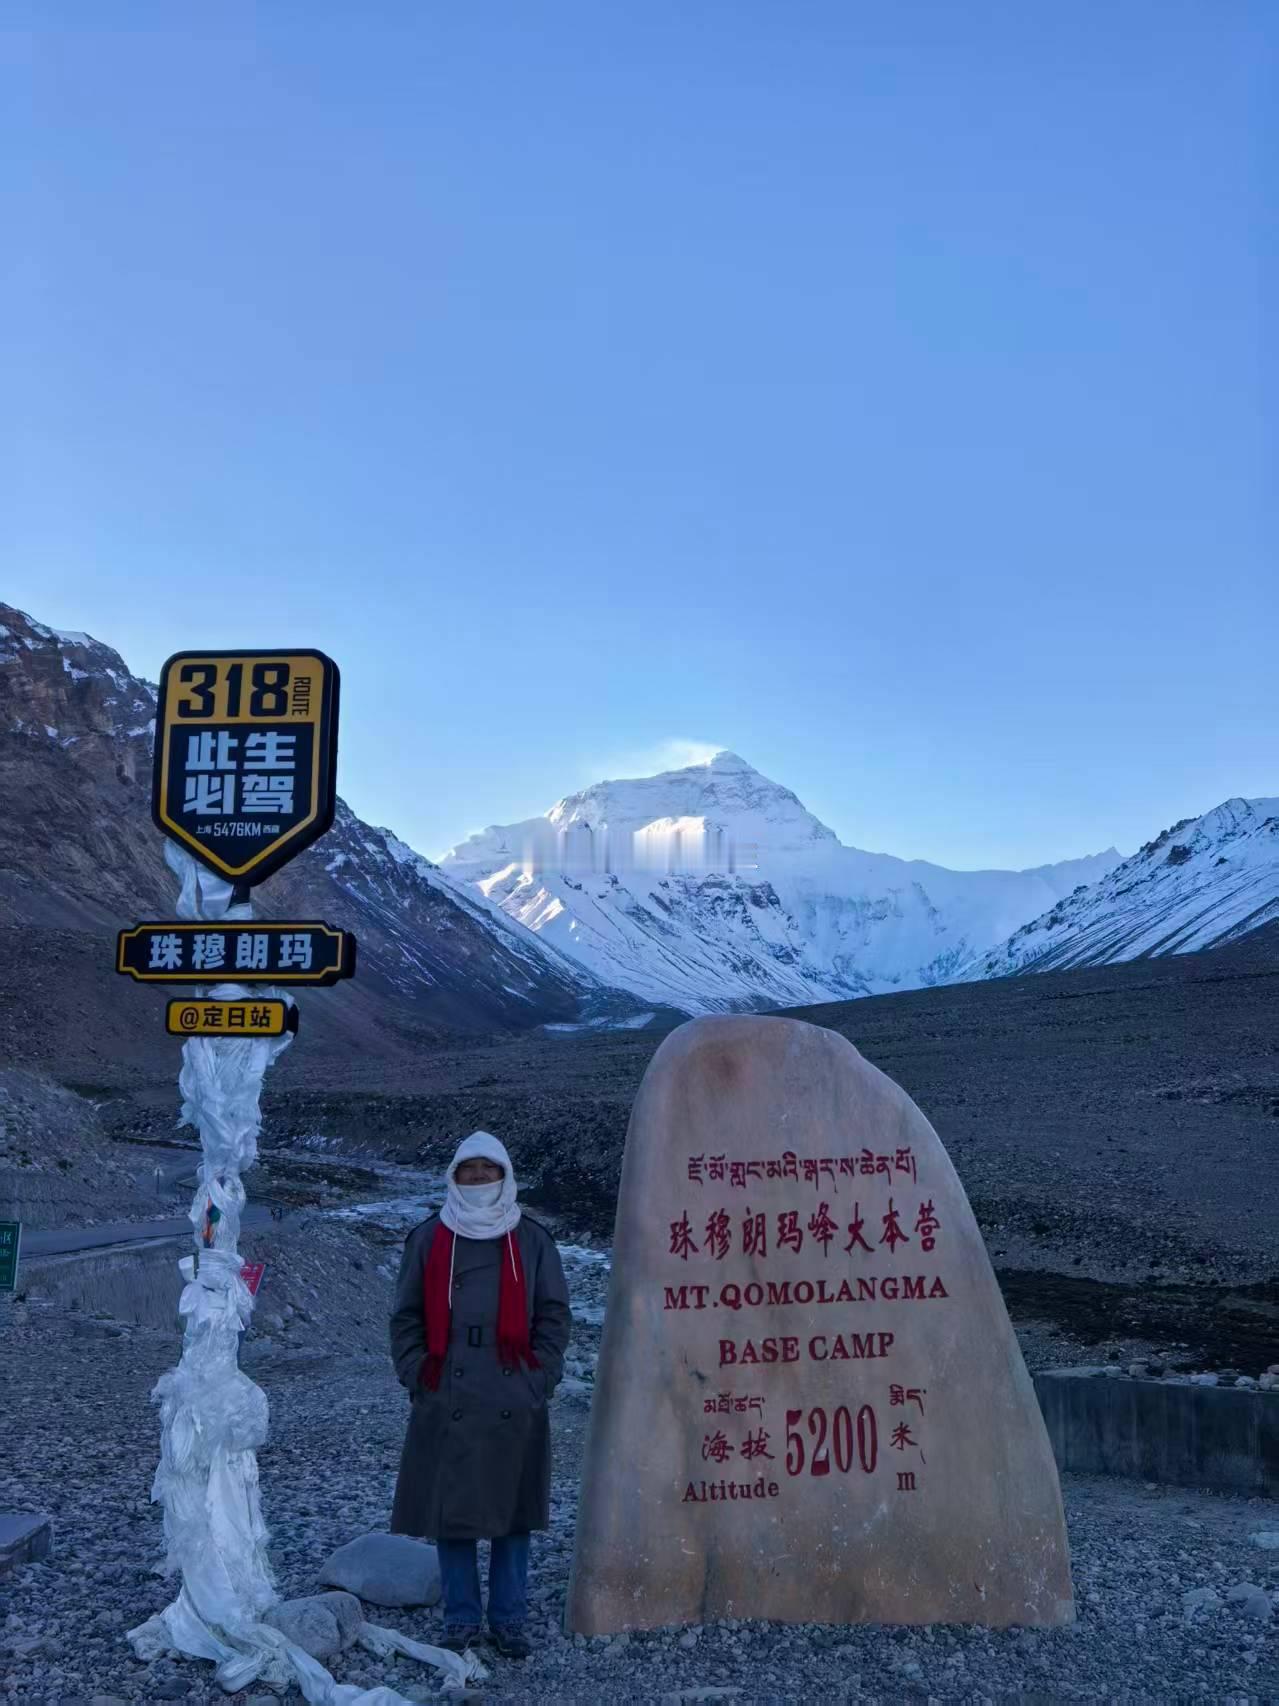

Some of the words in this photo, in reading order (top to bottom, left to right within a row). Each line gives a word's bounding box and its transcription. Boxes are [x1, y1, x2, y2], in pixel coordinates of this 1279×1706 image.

[177, 663, 290, 718] 318
[292, 677, 311, 716] ROUTE
[185, 731, 296, 771] 此生
[183, 774, 294, 815] 必驾
[213, 822, 261, 837] 5476KM
[148, 933, 313, 969] 珠穆朗玛
[180, 1006, 271, 1030] @定日站
[669, 1197, 941, 1261] 珠穆朗玛峰大本营
[719, 1337, 800, 1368] BASE
[809, 1332, 895, 1361] CAMP
[702, 1427, 775, 1463] 海拔
[785, 1404, 878, 1477] 5200
[890, 1421, 918, 1450] 米
[682, 1477, 780, 1502] Altitude
[896, 1471, 917, 1491] m
